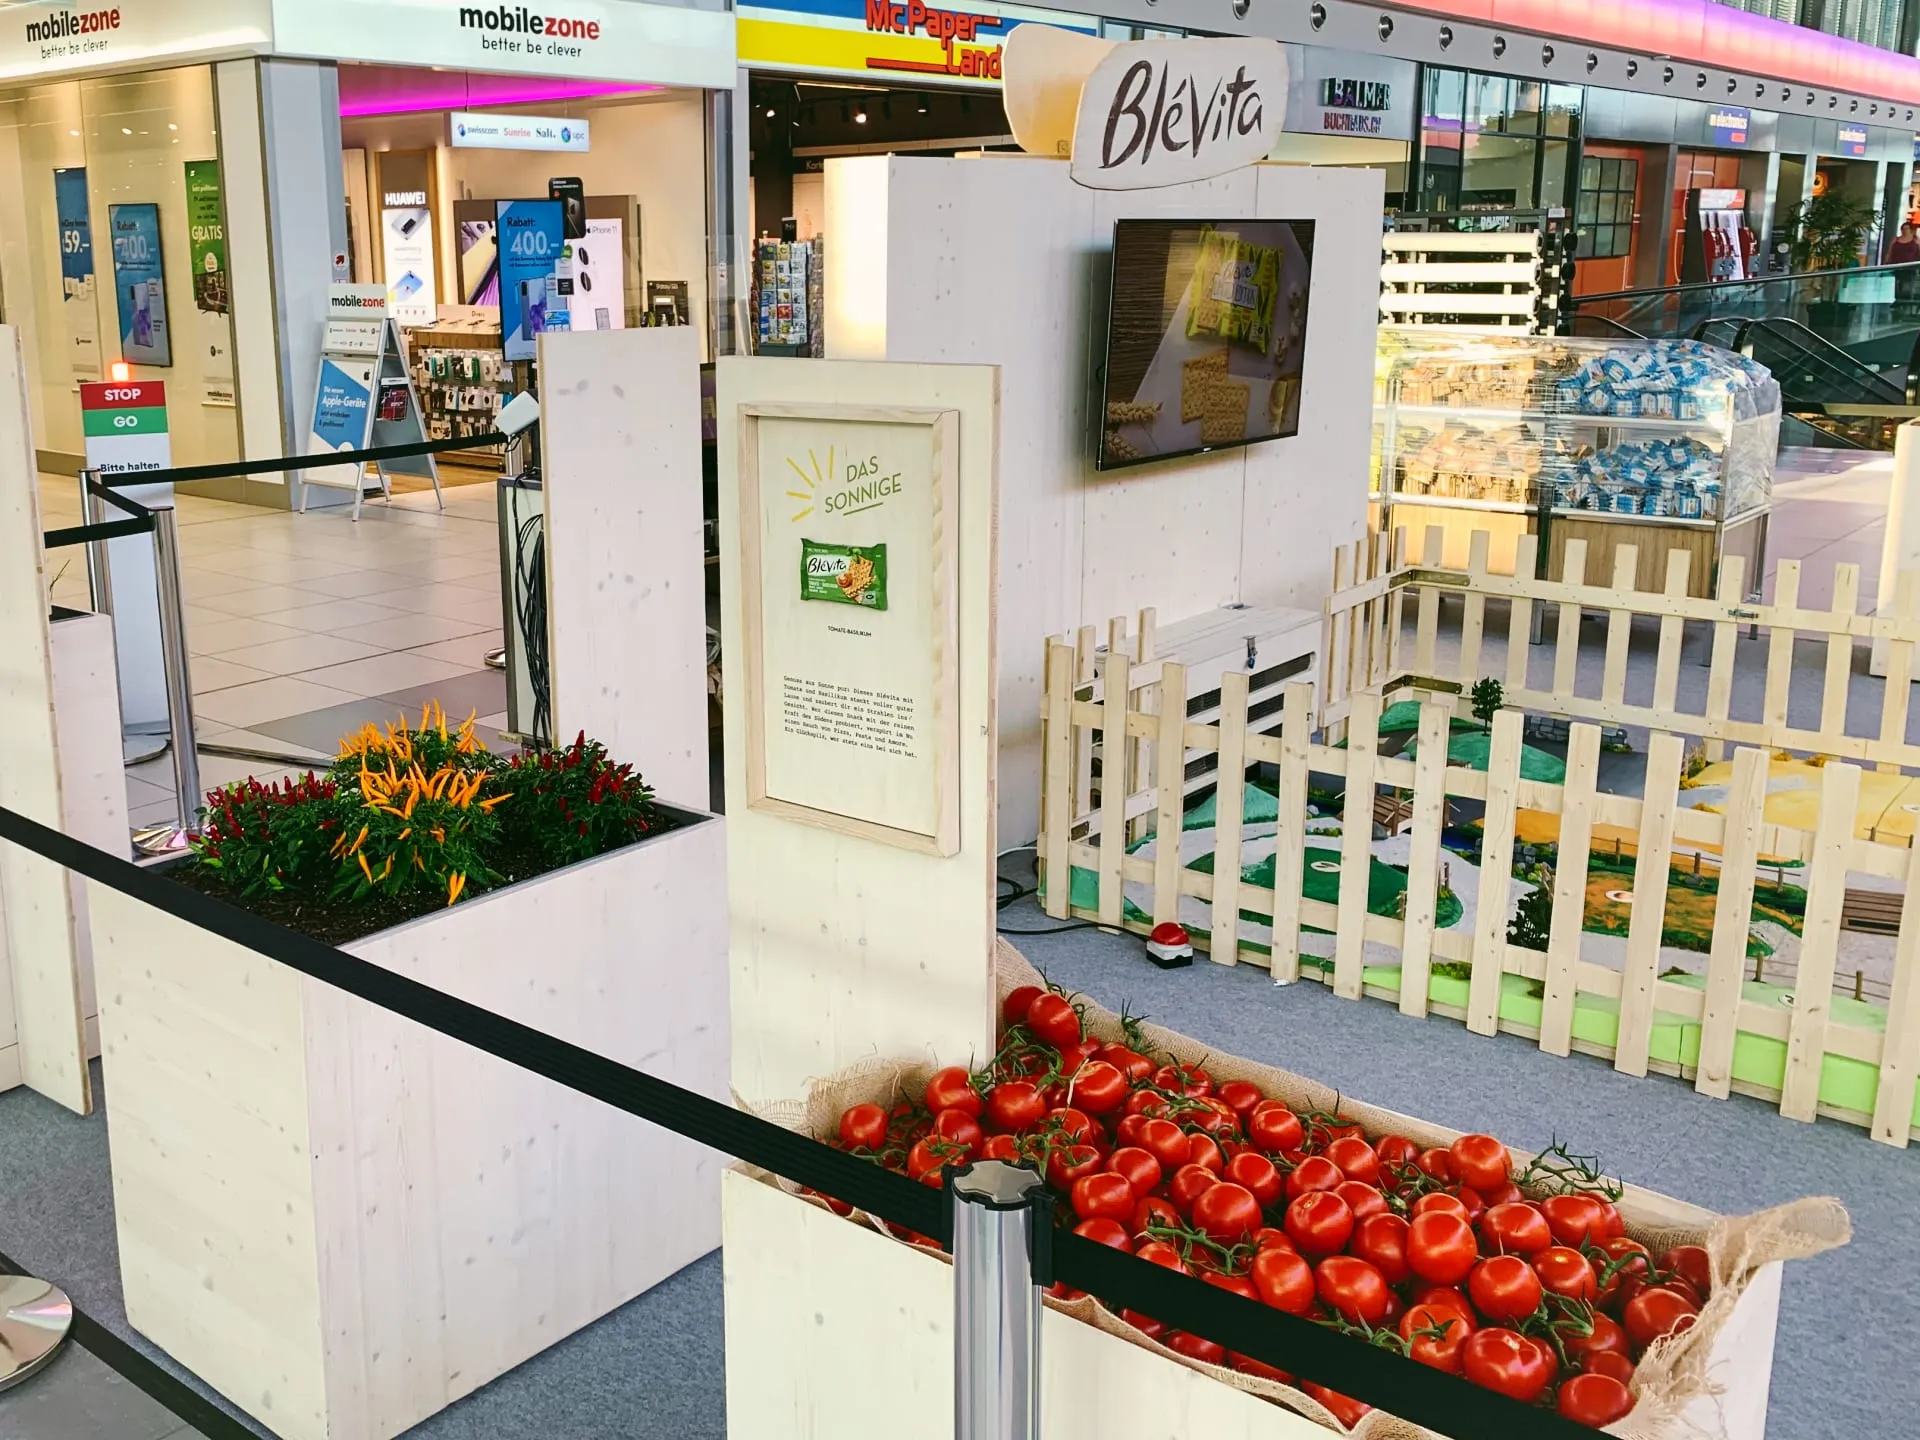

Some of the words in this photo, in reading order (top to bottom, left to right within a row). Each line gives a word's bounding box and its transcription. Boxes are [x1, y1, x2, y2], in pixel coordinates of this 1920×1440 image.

[26, 8, 121, 42] mobilezone
[459, 5, 600, 40] mobilezone
[41, 45, 66, 59] better
[69, 40, 80, 55] be
[83, 38, 108, 53] clever
[482, 34, 521, 52] better
[526, 38, 542, 54] be
[547, 40, 582, 58] clever
[945, 40, 1002, 80] Land
[467, 126, 499, 135] swisscom
[503, 127, 531, 137] Sunrise
[535, 127, 556, 139] Salt.
[384, 191, 426, 206] HUAWEI
[507, 217, 537, 228] Rabatt:
[191, 225, 223, 241] GRATIS
[331, 295, 385, 308] mobilezone
[104, 388, 142, 402] STOP
[113, 415, 138, 428] GO
[100, 463, 125, 473] Bitte
[127, 461, 160, 471] halten
[846, 455, 879, 484] DAS
[824, 472, 903, 514] SONNIGE
